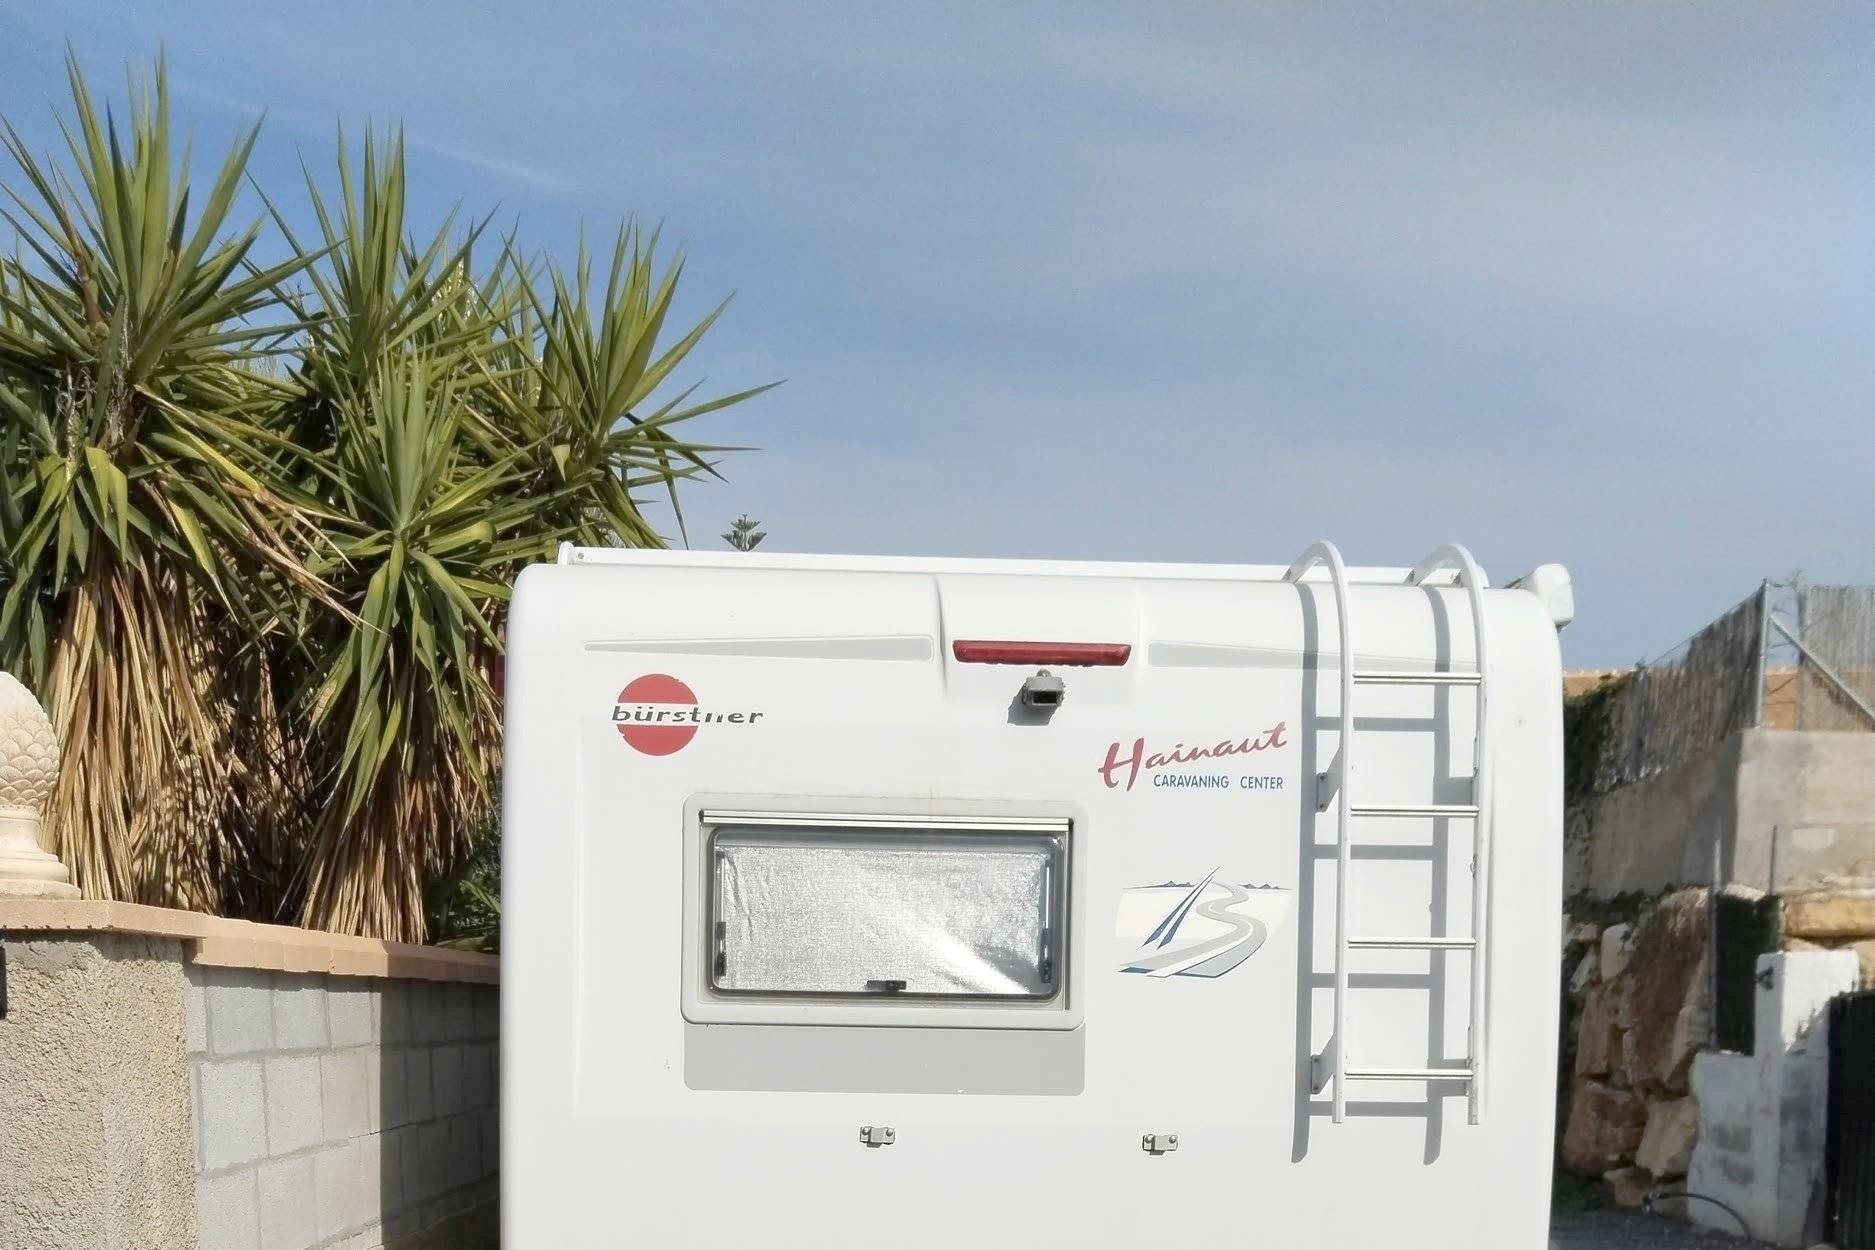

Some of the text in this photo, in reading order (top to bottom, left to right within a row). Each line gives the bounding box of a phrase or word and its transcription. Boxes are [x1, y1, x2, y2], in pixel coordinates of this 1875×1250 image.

[1098, 721, 1288, 792] Hainaut
[1153, 774, 1284, 790] CARAVANING CENTER
